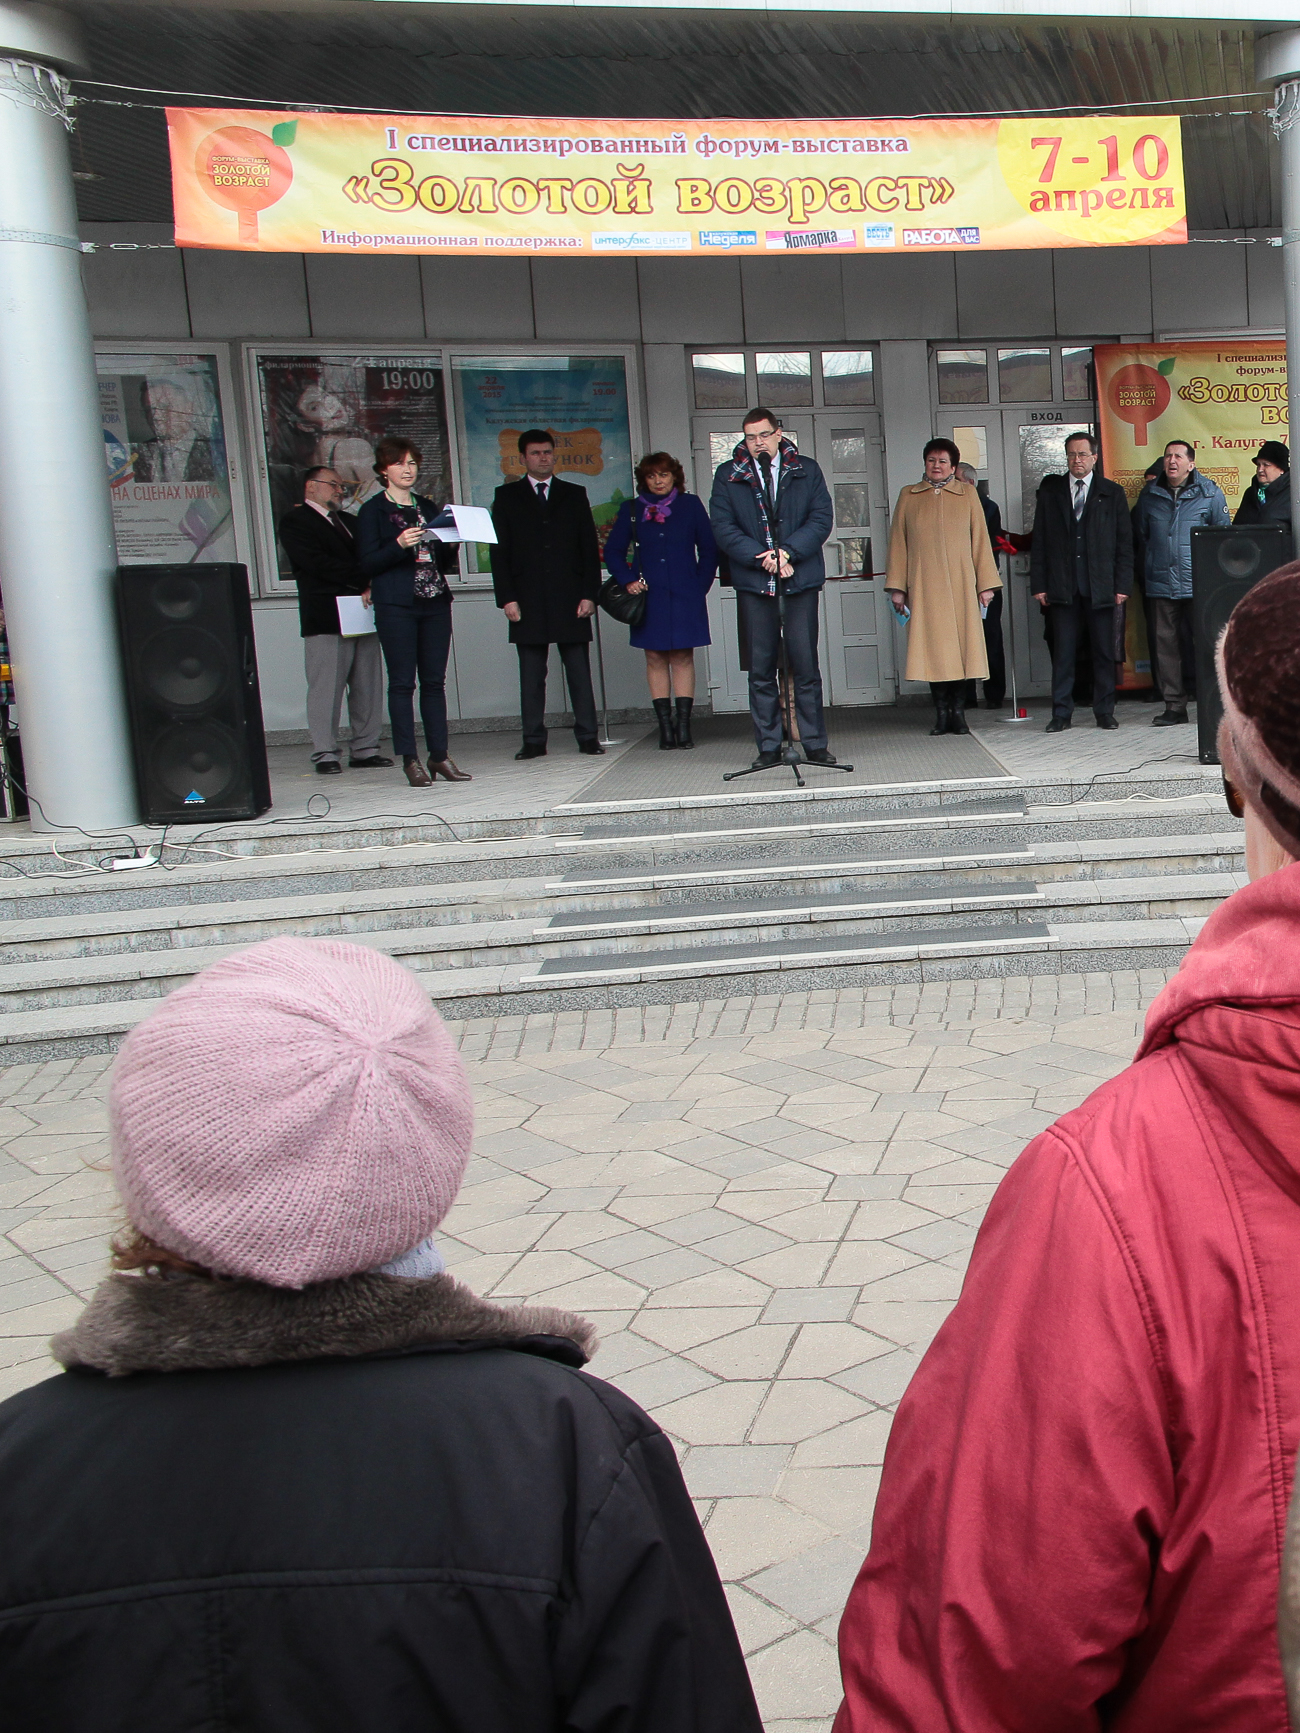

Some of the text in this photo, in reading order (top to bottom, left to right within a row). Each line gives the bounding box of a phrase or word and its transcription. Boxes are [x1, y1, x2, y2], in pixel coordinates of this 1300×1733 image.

[406, 131, 686, 157] специализированный
[694, 133, 910, 157] форум-выставка
[212, 156, 270, 164] ФОРУМ-ВЫСТАВКА
[1030, 134, 1170, 183] 7-10
[212, 164, 271, 175] ЗОЛОТОЙ
[214, 175, 270, 187] ВОЗРАСТ
[343, 158, 956, 224] «Золотой возраст»
[1029, 186, 1175, 217] апреля
[866, 228, 889, 239] ВЕСТЬ
[903, 229, 962, 245] РАБОТА
[960, 228, 976, 237] ДЛЯ
[321, 230, 584, 250] Информационная поддержка:
[701, 232, 756, 248] Неделя
[784, 230, 839, 249] Ярмарка
[965, 236, 980, 244] ВАС
[1236, 366, 1287, 377] форум-в
[381, 371, 435, 390] 19:00
[485, 377, 498, 385] 22
[483, 391, 502, 399] 2015
[1119, 390, 1156, 399] ЗОЛОТОЙ
[1119, 399, 1156, 407] ВОЗРАСТ
[485, 417, 527, 425] Калужская
[528, 415, 566, 424] областная
[1031, 412, 1064, 421] ВХОД
[112, 484, 221, 501] НА СЦЕНАХ МИРА
